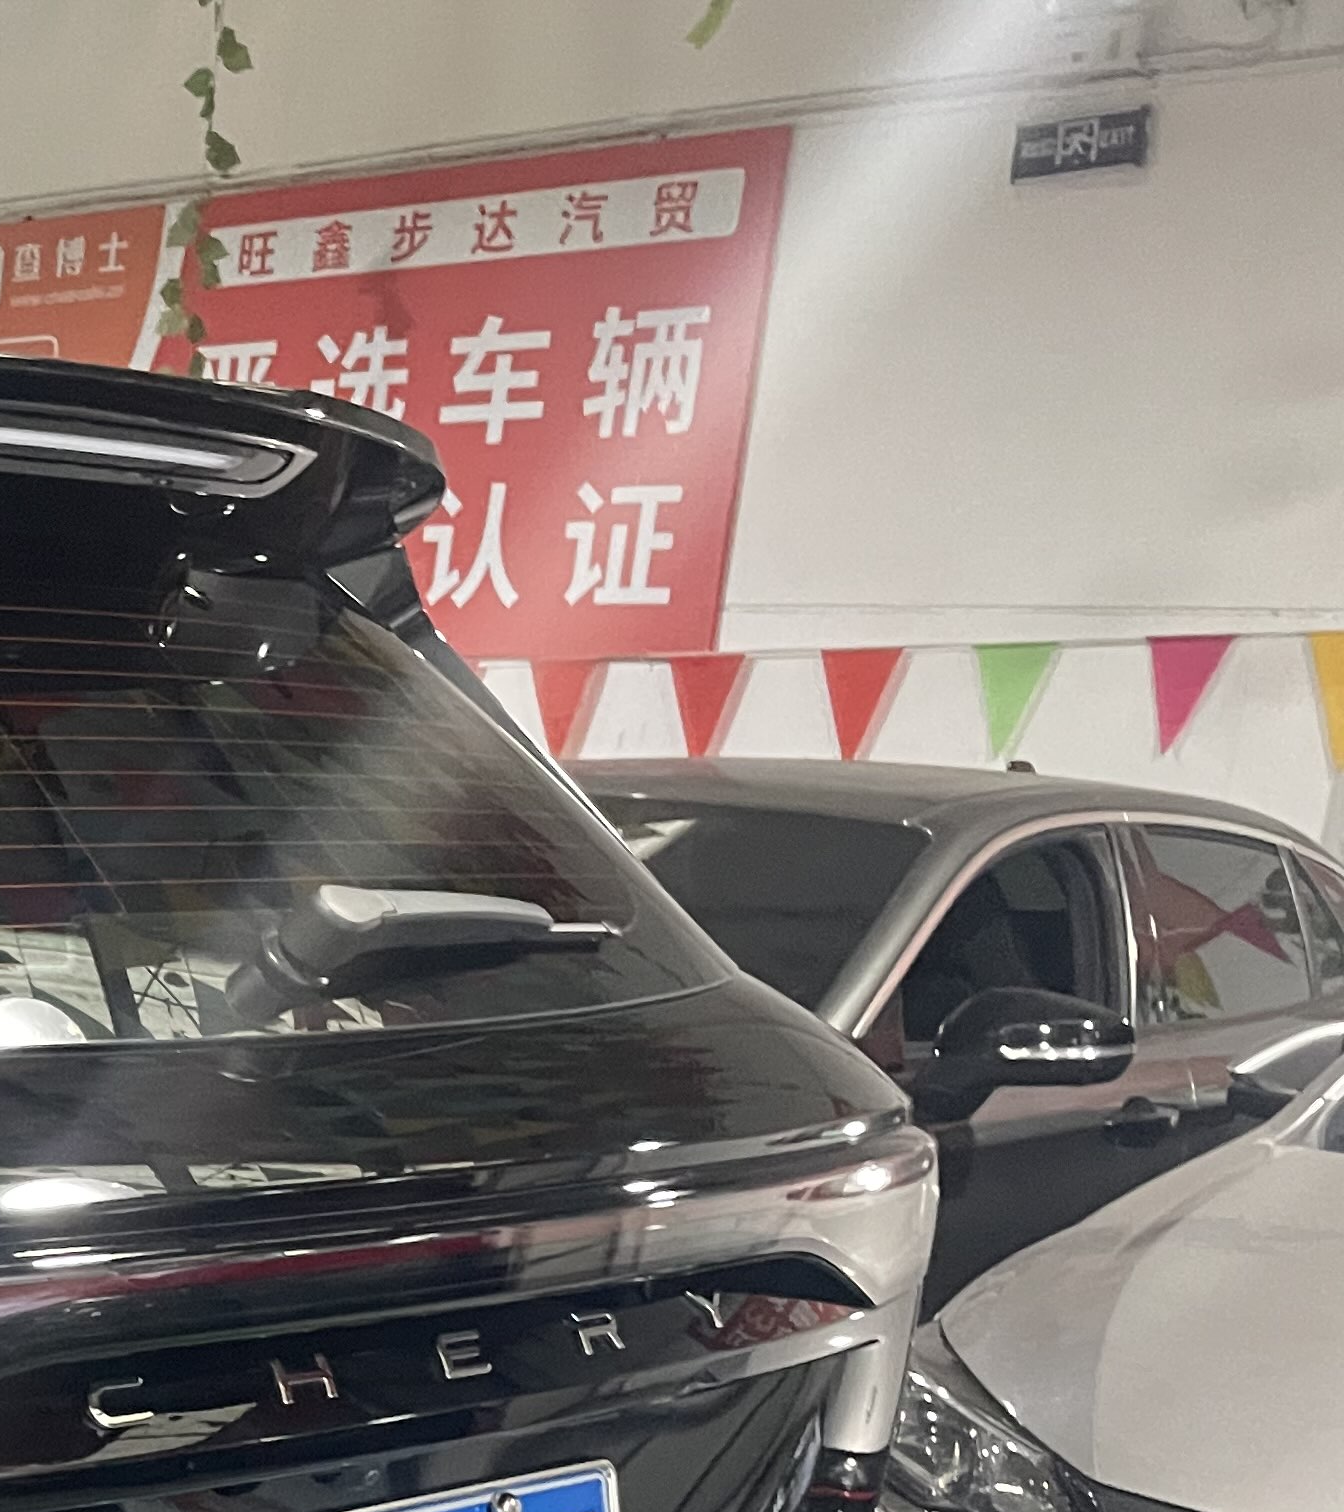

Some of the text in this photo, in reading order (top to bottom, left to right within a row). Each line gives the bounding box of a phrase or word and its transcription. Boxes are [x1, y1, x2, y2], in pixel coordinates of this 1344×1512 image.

[237, 180, 700, 277] 旺鑫步达汽贸
[422, 481, 684, 608] 认证
[87, 1289, 728, 1429] CHERY
